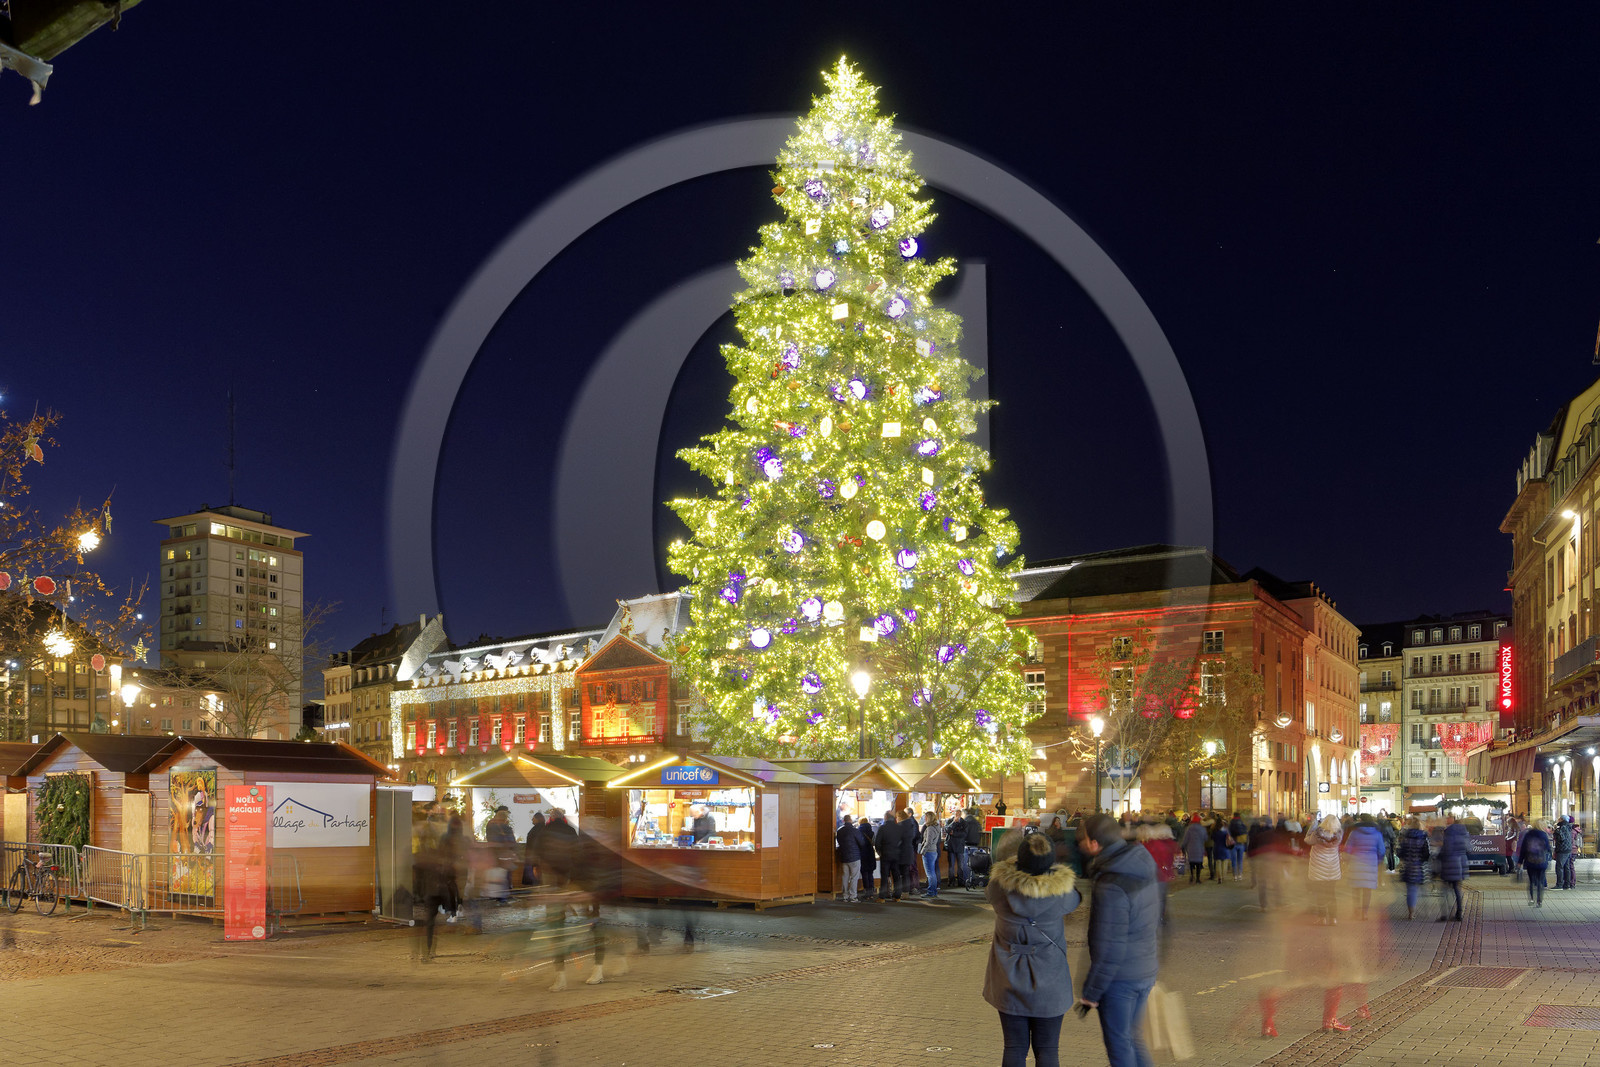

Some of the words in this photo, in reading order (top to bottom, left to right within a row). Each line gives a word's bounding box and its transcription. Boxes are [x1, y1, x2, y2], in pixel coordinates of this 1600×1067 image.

[1502, 646, 1512, 697] MONOPRIX
[666, 767, 700, 781] unicef
[235, 795, 255, 804] NOËL
[272, 816, 305, 833] llage
[323, 814, 368, 832] Partage
